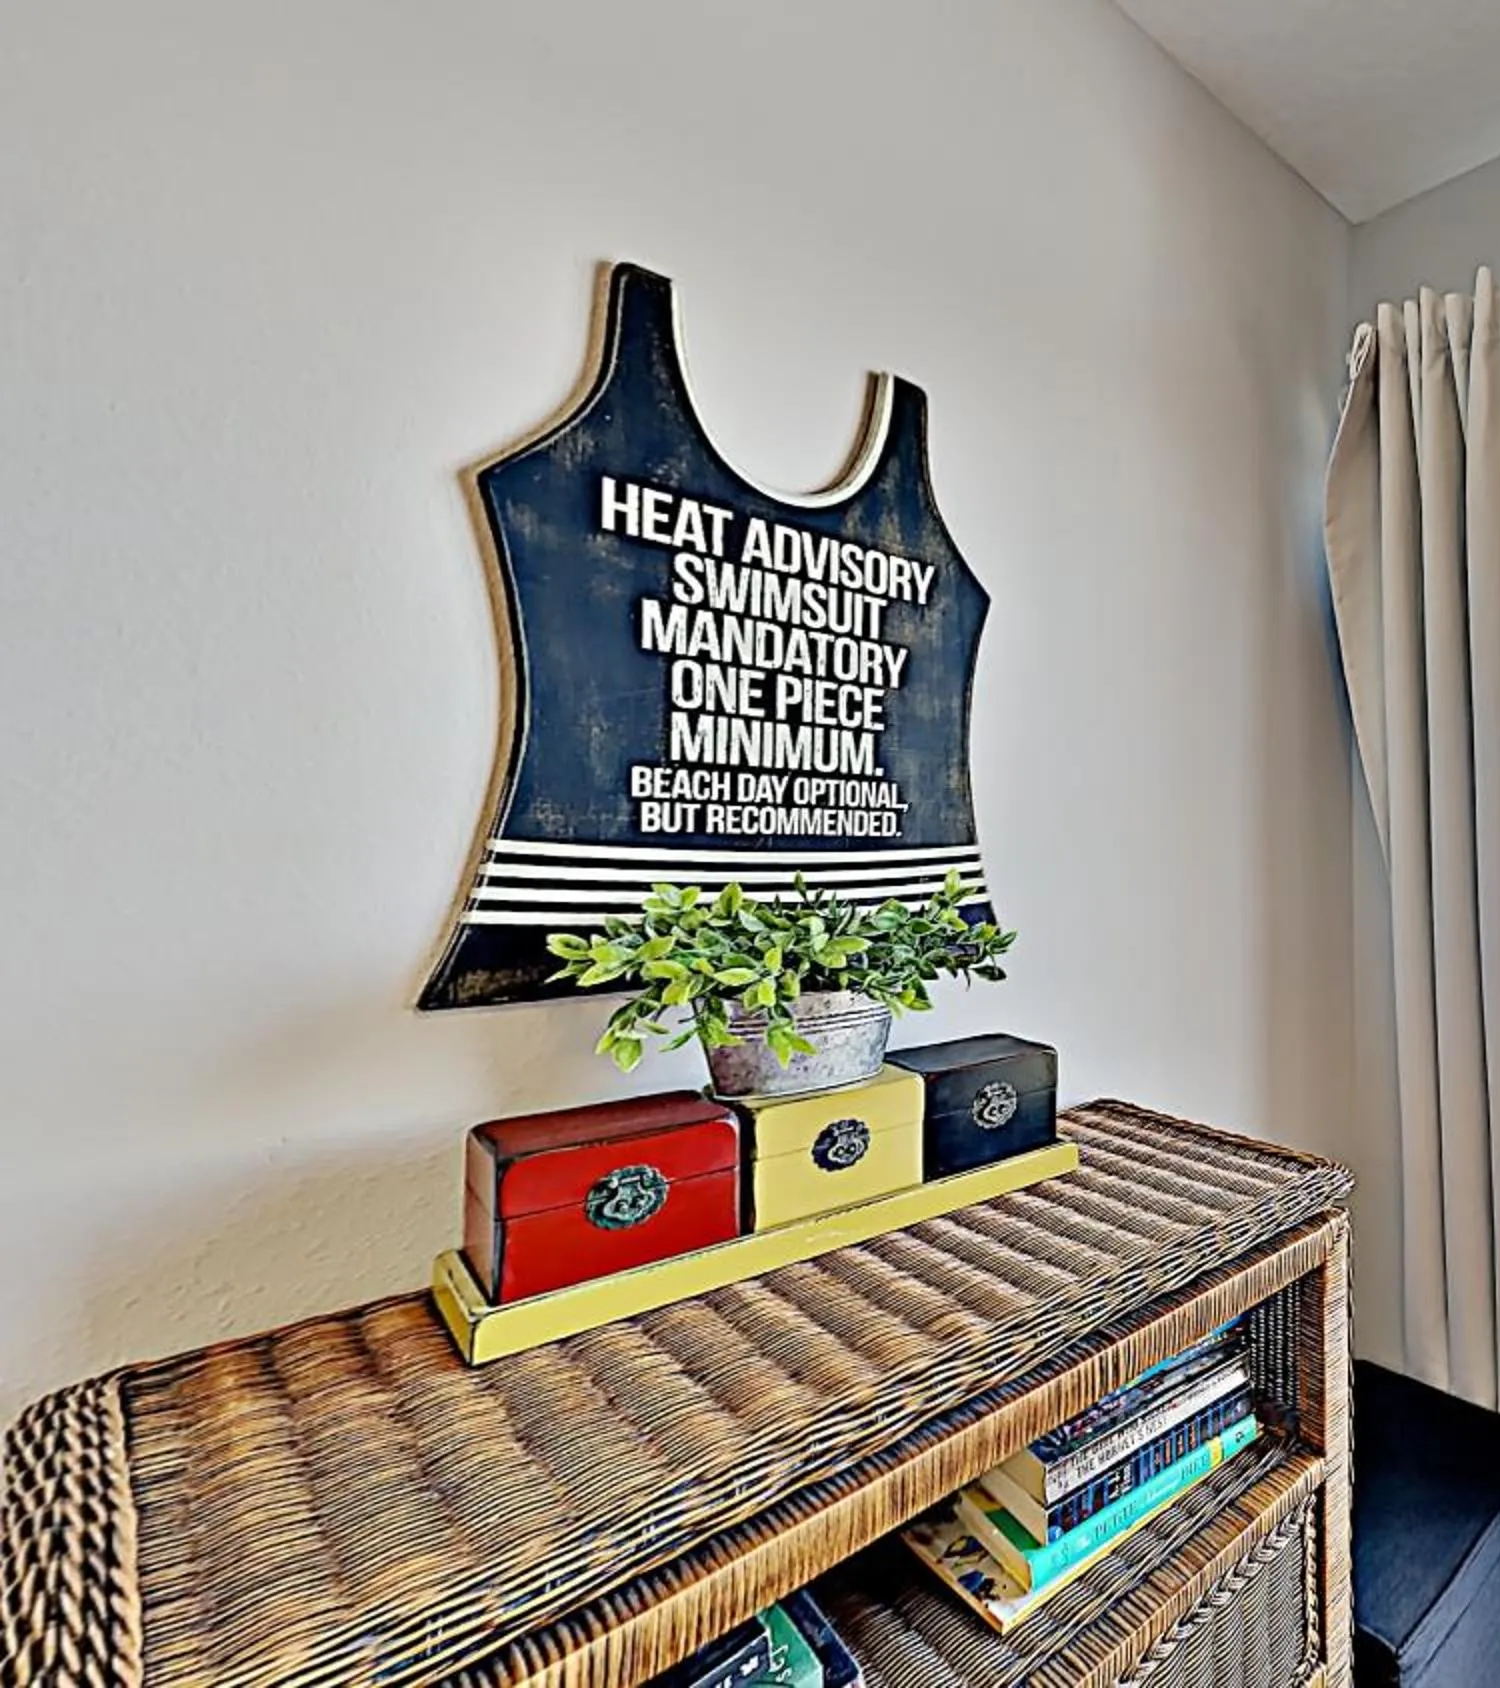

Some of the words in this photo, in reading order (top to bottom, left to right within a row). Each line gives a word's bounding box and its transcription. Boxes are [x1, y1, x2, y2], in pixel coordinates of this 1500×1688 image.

[601, 476, 734, 558] HEAT
[741, 517, 935, 605] ADVISORY
[672, 552, 888, 640] SWIMSUIT
[640, 597, 908, 688] MANDATORY
[671, 659, 765, 718] ONE
[775, 676, 885, 731] PIECE
[670, 711, 885, 777] MINIMUM.
[630, 765, 731, 802] BEACH
[737, 772, 789, 804] DAY
[793, 777, 909, 812] OPTIONAL,
[640, 802, 700, 834] BUT
[706, 805, 903, 838] RECOMMENDED.
